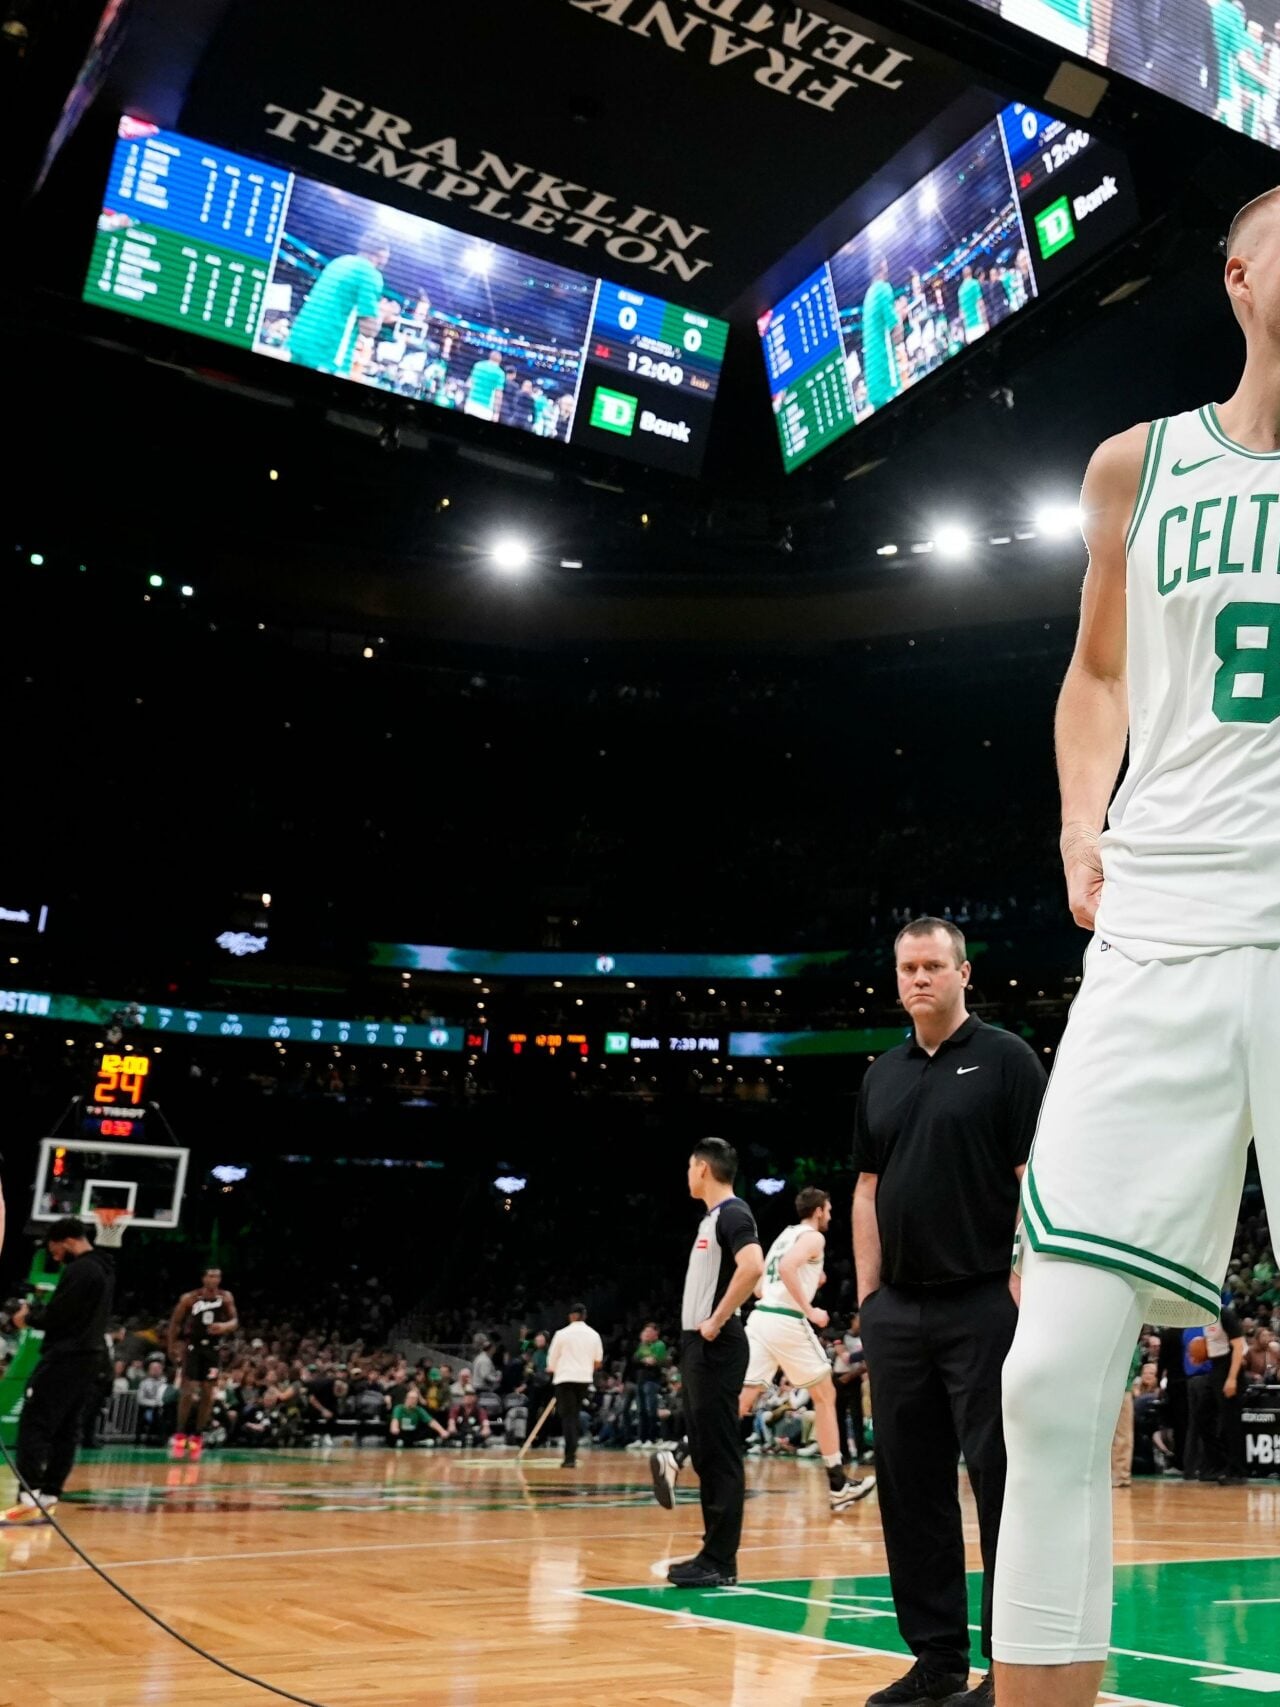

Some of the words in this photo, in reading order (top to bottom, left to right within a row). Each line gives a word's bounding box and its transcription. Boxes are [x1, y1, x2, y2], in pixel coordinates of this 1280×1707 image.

[306, 86, 711, 251] FRANKLIN
[263, 103, 713, 282] TEMPLETON
[1073, 175, 1119, 221] Bank
[618, 306, 638, 331] 0
[683, 328, 702, 352] 0
[627, 351, 684, 386] 12:00
[599, 393, 633, 427] TD
[639, 409, 692, 443] Bank
[630, 1036, 661, 1051] Bank
[698, 1037, 720, 1051] PM
[94, 1071, 143, 1105] 24
